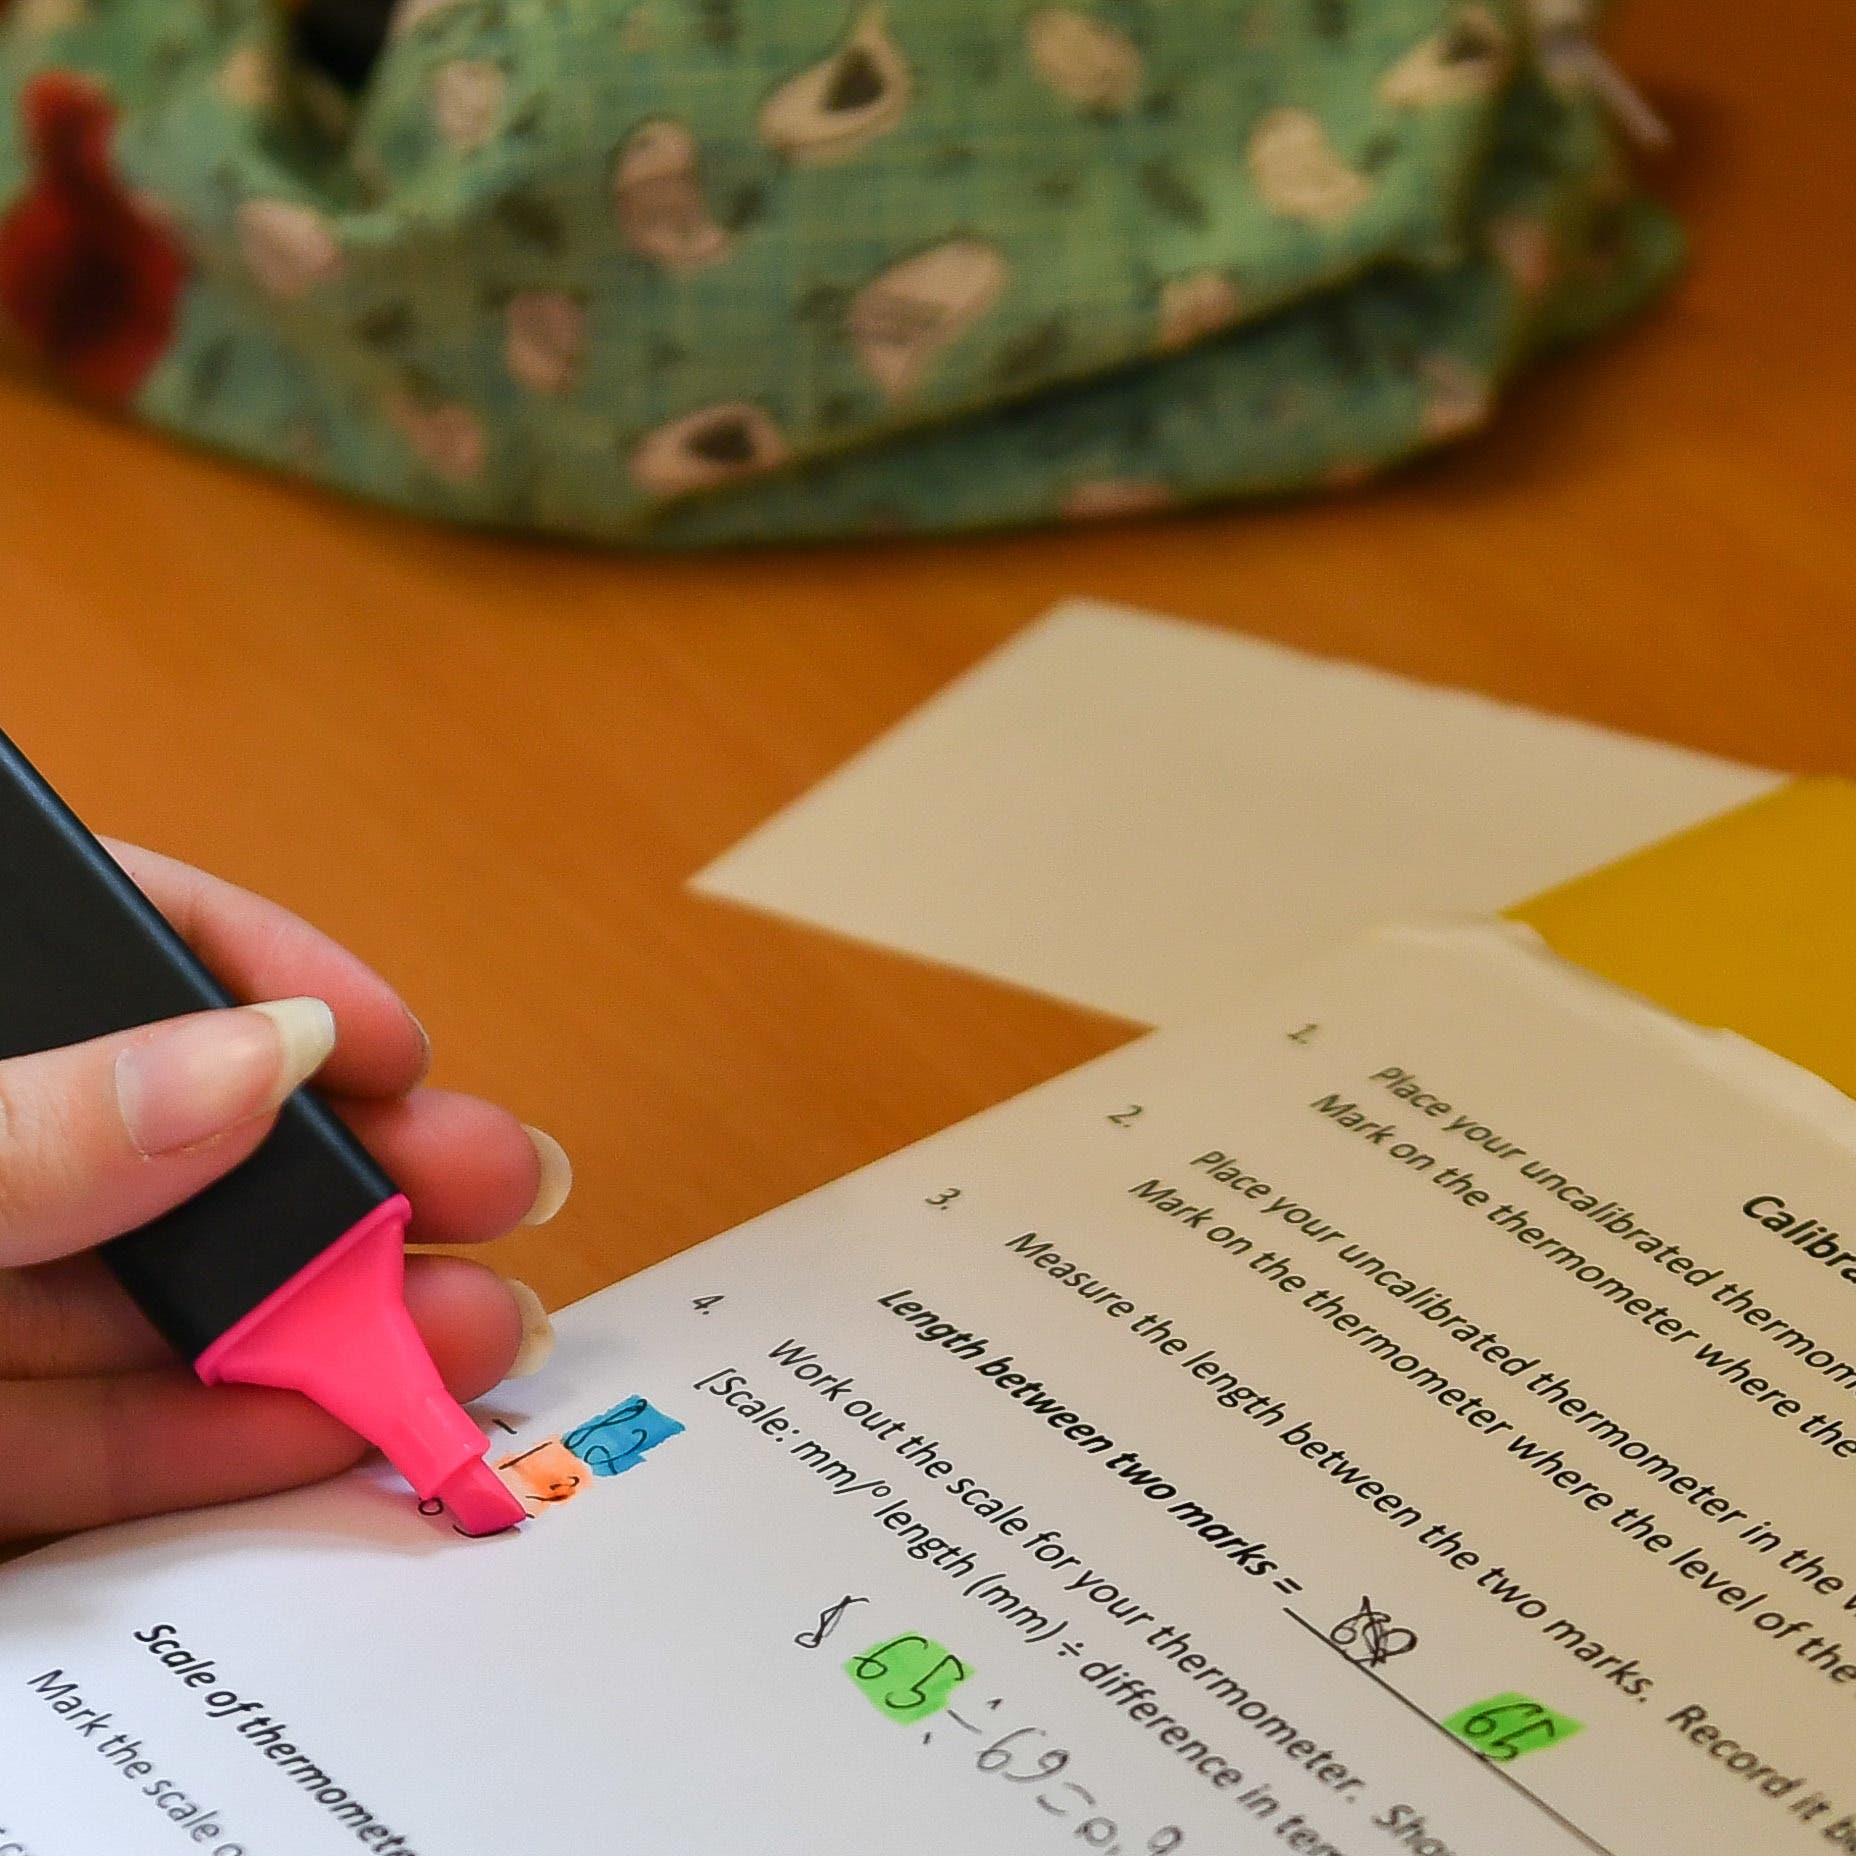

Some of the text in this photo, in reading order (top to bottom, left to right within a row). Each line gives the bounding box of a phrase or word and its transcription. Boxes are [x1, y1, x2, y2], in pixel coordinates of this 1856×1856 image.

[1105, 1105, 1144, 1129] 2.
[1286, 1024, 1318, 1045] 1.
[923, 1188, 962, 1211] 3.
[1308, 1094, 1397, 1146] Mark
[1387, 1144, 1435, 1171] on
[1430, 1168, 1490, 1208] the
[1485, 1205, 1700, 1343] thermometer
[1693, 1344, 1801, 1418] where
[1368, 1068, 1452, 1117] Place
[1440, 1115, 1526, 1160] your
[1519, 1161, 1724, 1287] uncalibrated
[691, 1296, 725, 1316] 4.
[1189, 1151, 1271, 1199] Place
[1259, 1197, 1346, 1243] your
[1337, 1245, 1541, 1377] uncalibrated
[1526, 1373, 1747, 1523] thermometer
[1738, 1522, 1781, 1553] in
[1778, 1550, 1844, 1595] the
[498, 1441, 580, 1501] 13
[563, 1398, 648, 1476] 82
[876, 1290, 990, 1361] Length
[973, 1357, 1113, 1454] between
[1104, 1453, 1176, 1500] two
[1166, 1502, 1278, 1576] marks
[1271, 1578, 1302, 1594] =
[1127, 1180, 1214, 1229] Mark
[1205, 1227, 1253, 1256] on
[1248, 1252, 1306, 1293] the
[1301, 1290, 1514, 1435] thermometer
[1506, 1436, 1613, 1511] where
[1609, 1508, 1673, 1553] the
[1668, 1548, 1767, 1611] level
[1753, 1612, 1813, 1638] of
[692, 1368, 799, 1443] [Scale:
[873, 1499, 976, 1577] length
[962, 1573, 1068, 1642] (mm)
[1056, 1642, 1084, 1657] ÷
[1078, 1662, 1243, 1791] difference
[1235, 1784, 1280, 1820] in
[768, 1338, 853, 1401] Work
[843, 1400, 905, 1440] out
[895, 1436, 952, 1478] the
[945, 1478, 1028, 1535] scale
[1022, 1531, 1081, 1569] for
[1064, 1570, 1154, 1625] your
[1145, 1625, 1365, 1802] thermometer.
[1003, 1233, 1134, 1318] Measure
[1129, 1315, 1188, 1356] the
[1179, 1351, 1286, 1427] length
[1278, 1421, 1421, 1527] between
[1417, 1525, 1479, 1570] the
[1475, 1568, 1547, 1619] two
[1540, 1620, 1653, 1704] marks.
[1664, 1705, 1805, 1799] Record
[1788, 1793, 1830, 1824] it
[25, 1669, 114, 1738] Mark
[95, 1734, 155, 1780] the
[140, 1780, 223, 1844] scale
[132, 1625, 217, 1689] Scale
[203, 1691, 264, 1718] of
[1464, 1702, 1554, 1763] 65
